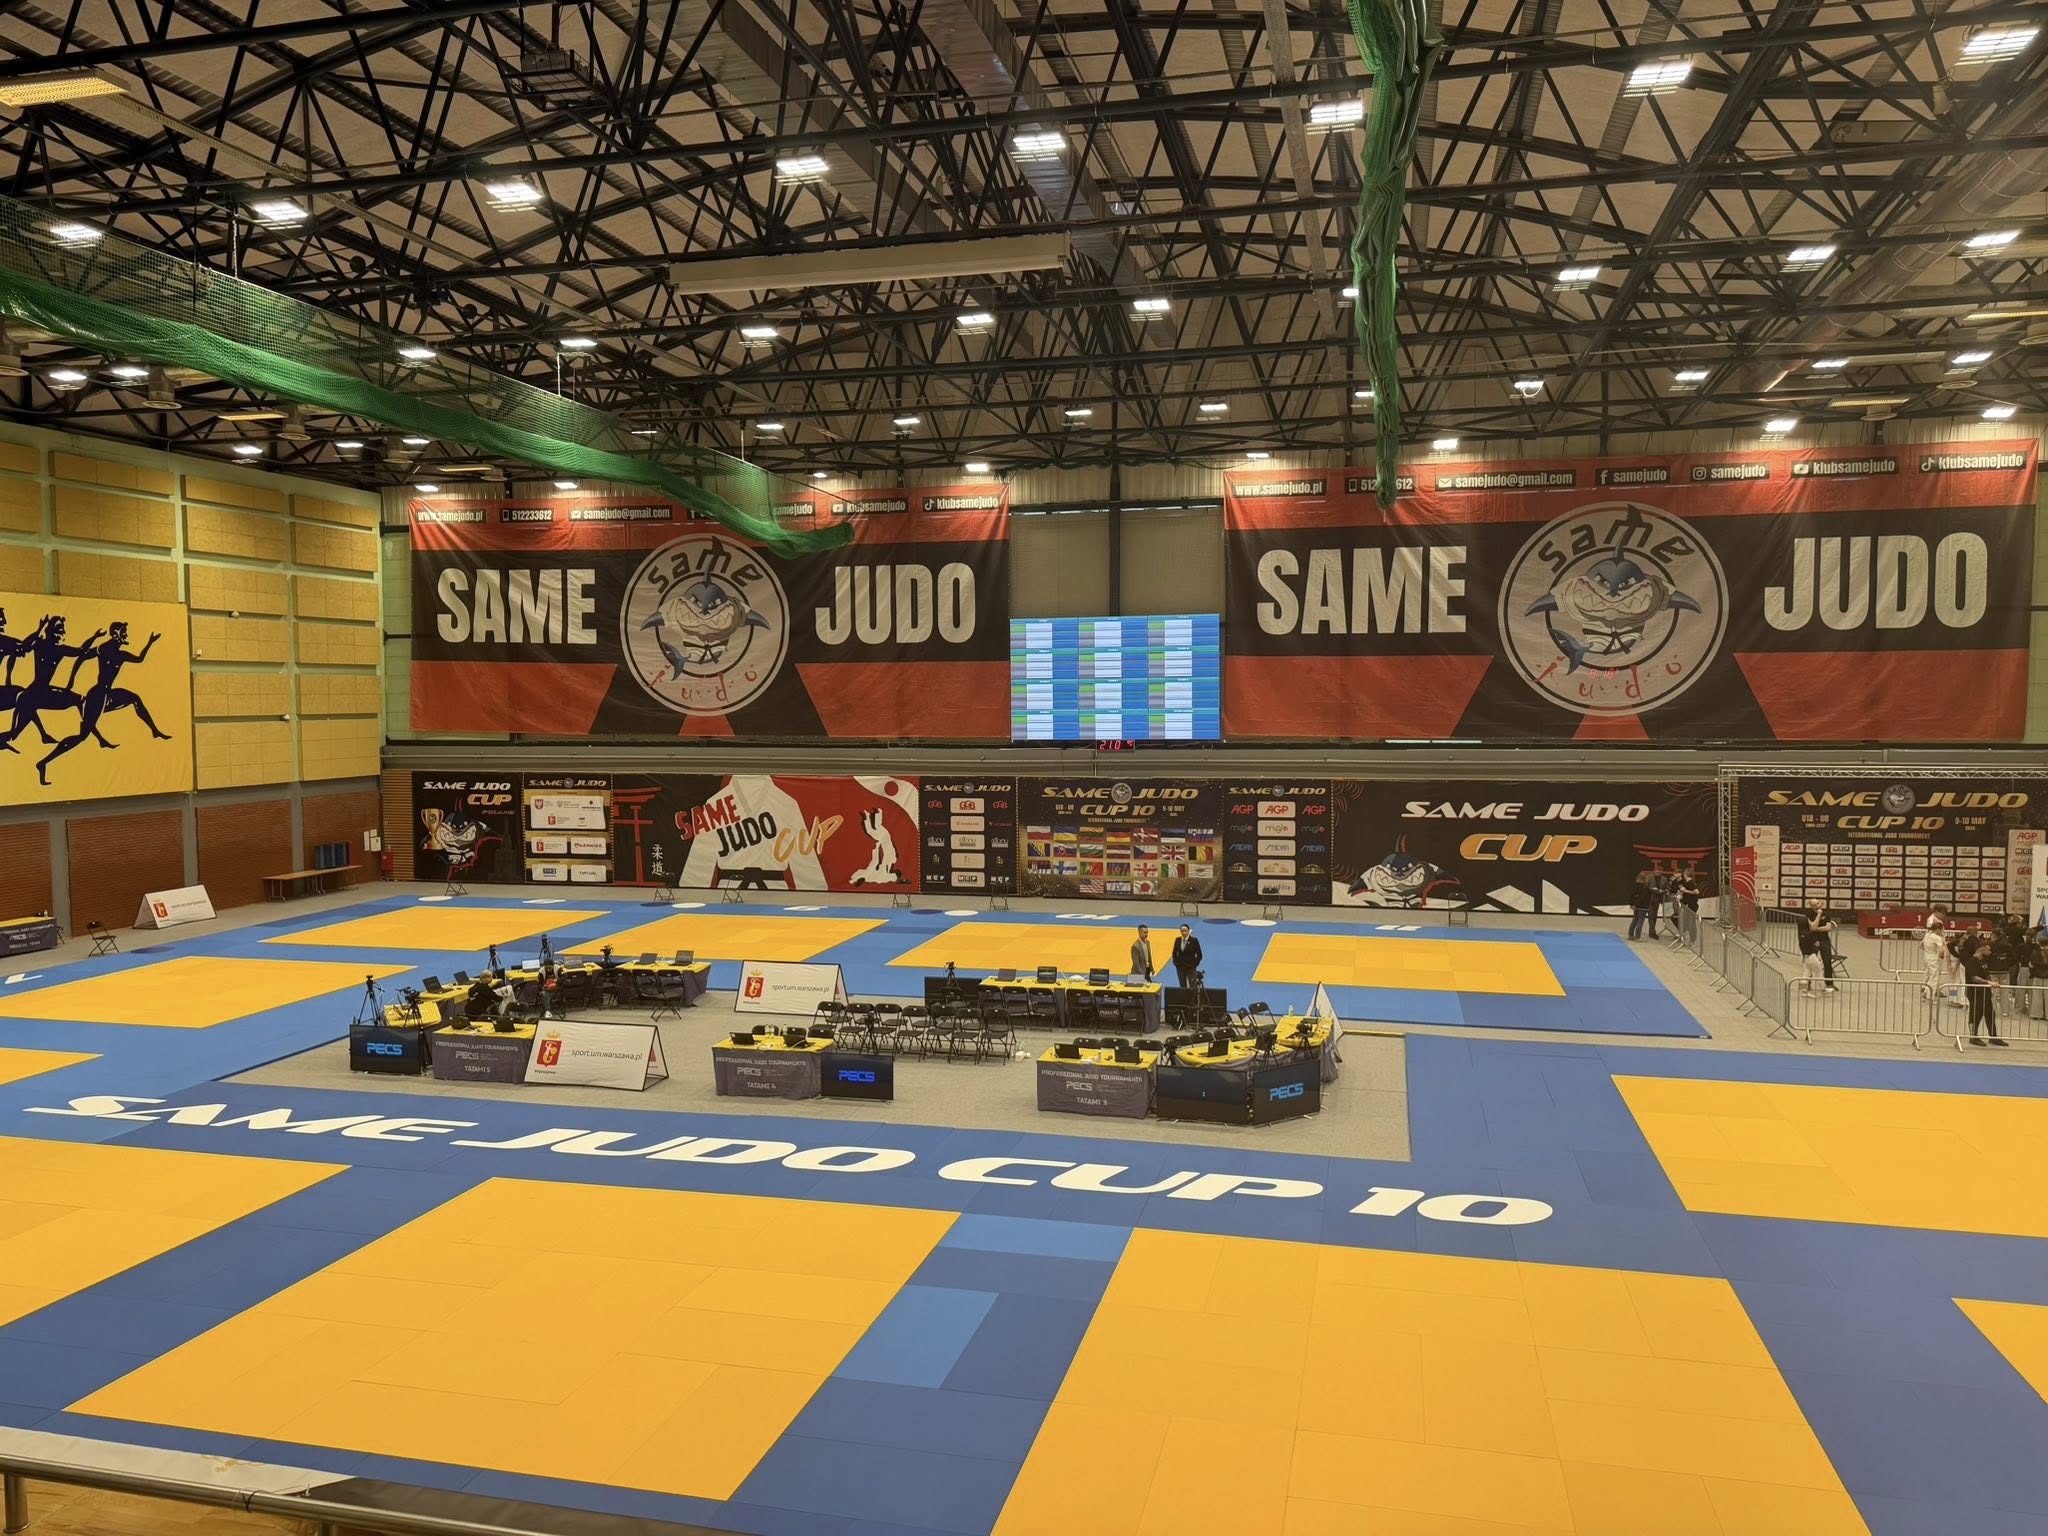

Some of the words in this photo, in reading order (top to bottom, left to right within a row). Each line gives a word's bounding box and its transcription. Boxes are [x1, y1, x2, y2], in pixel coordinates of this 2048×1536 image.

[1813, 459, 1895, 475] klubsamejudo
[1938, 453, 2024, 470] klubsamejudo
[1613, 467, 1667, 484] samejudo
[1710, 464, 1766, 480] samejudo
[1361, 479, 1413, 492] 512612
[1455, 472, 1573, 488] samejudo@gmail.com
[1235, 481, 1322, 496] www.samejudo.pl
[937, 497, 998, 511] klubsamejudo
[512, 510, 552, 521] 512233612
[584, 507, 670, 520] samejudo@gmail.com
[1764, 532, 1988, 632] JUDO
[1256, 546, 1467, 635] SAME
[436, 568, 597, 645] SAME
[815, 563, 976, 645] JUDO
[423, 781, 467, 790] SAME
[470, 782, 511, 790] JUDO
[924, 784, 963, 792] SAME
[1228, 787, 1272, 795] SAME
[1285, 787, 1326, 795] JUDO
[467, 794, 512, 805] CUP
[1041, 787, 1112, 798] SAME
[1132, 788, 1199, 799] JUDO
[1764, 790, 1882, 807] SAME
[1916, 792, 2028, 809] JUDO
[1080, 804, 1128, 816] CUP
[1132, 805, 1156, 816] 10
[1231, 805, 1254, 814] AGP
[1265, 805, 1289, 815] AGP
[1302, 805, 1327, 815] AGP
[1401, 801, 1523, 820] SAME
[1534, 803, 1650, 822] JUDO
[675, 794, 741, 841] SAME
[1837, 815, 1906, 829] CUP
[1911, 816, 1946, 830] 10
[716, 811, 777, 857] JUDO
[772, 815, 845, 864] CUP
[2016, 832, 2037, 840] AGP
[1459, 833, 1597, 862] CUP
[1881, 916, 1886, 924] 2
[367, 1042, 402, 1055] PECS
[455, 1050, 479, 1060] PECS
[571, 1048, 642, 1061] sport.um.warszawa.pl
[464, 1065, 485, 1073] TATAMI
[737, 1067, 761, 1076] PECS
[838, 1070, 875, 1083] PECS
[1041, 1070, 1083, 1079] PROFESSIONAL
[1100, 1075, 1143, 1083] TOURNAMENTS
[1066, 1081, 1092, 1091] PECS
[1269, 1083, 1304, 1101] PECS
[1076, 1097, 1101, 1105] TATAMI
[24, 1095, 478, 1142] SAME
[450, 1128, 915, 1173] JUDO
[938, 1157, 1323, 1201] CUP
[1349, 1187, 1553, 1225] 10
